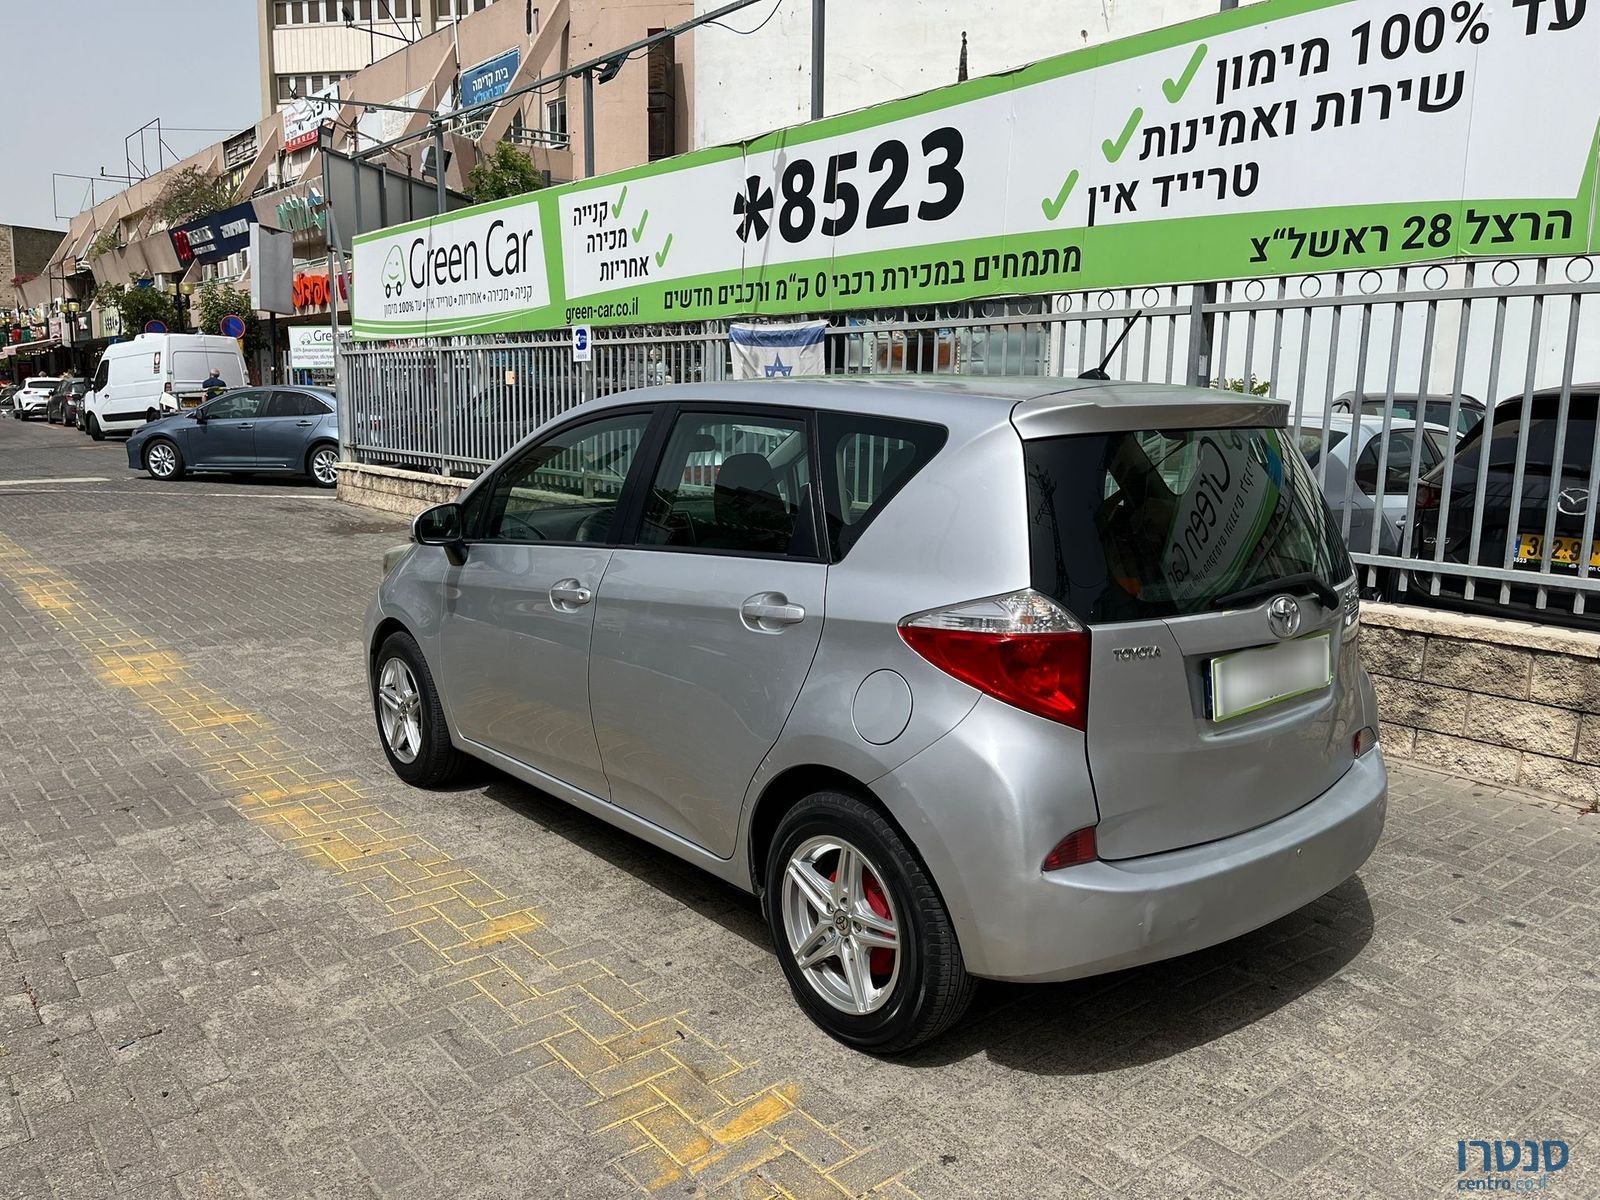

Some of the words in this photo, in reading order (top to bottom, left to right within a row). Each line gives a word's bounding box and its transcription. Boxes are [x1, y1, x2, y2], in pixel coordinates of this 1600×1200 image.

[1512, 0, 1587, 36] עד
[1351, 0, 1490, 66] 100%
[472, 72, 494, 92] קדימה
[495, 67, 509, 82] בית
[1216, 37, 1330, 105] מימון
[1310, 67, 1465, 132] שירות
[1138, 98, 1298, 162] ואמינות
[1152, 161, 1260, 208] טרייד
[572, 201, 609, 228] קנייה
[1086, 180, 1140, 228] אין
[586, 228, 629, 254] מכירה
[1400, 213, 1453, 251] 28
[1465, 209, 1573, 246] הרצל
[408, 237, 479, 289] Green
[485, 219, 534, 278] Car
[1249, 225, 1390, 264] ראשל"צ
[599, 255, 651, 283] אחריות
[881, 260, 966, 292] במכירת
[974, 245, 1081, 282] מתמחים
[487, 288, 509, 303] מכירה
[514, 285, 533, 302] קניה
[718, 280, 770, 305] ורכבים
[815, 271, 827, 298] 0
[832, 270, 875, 296] רכבי
[399, 301, 414, 313] 100%
[436, 295, 453, 308] טרייד
[458, 291, 482, 306] אחריות
[565, 296, 639, 325] green-car.co.il
[664, 286, 713, 309] חדשים
[1112, 645, 1161, 662] TOYOTA
